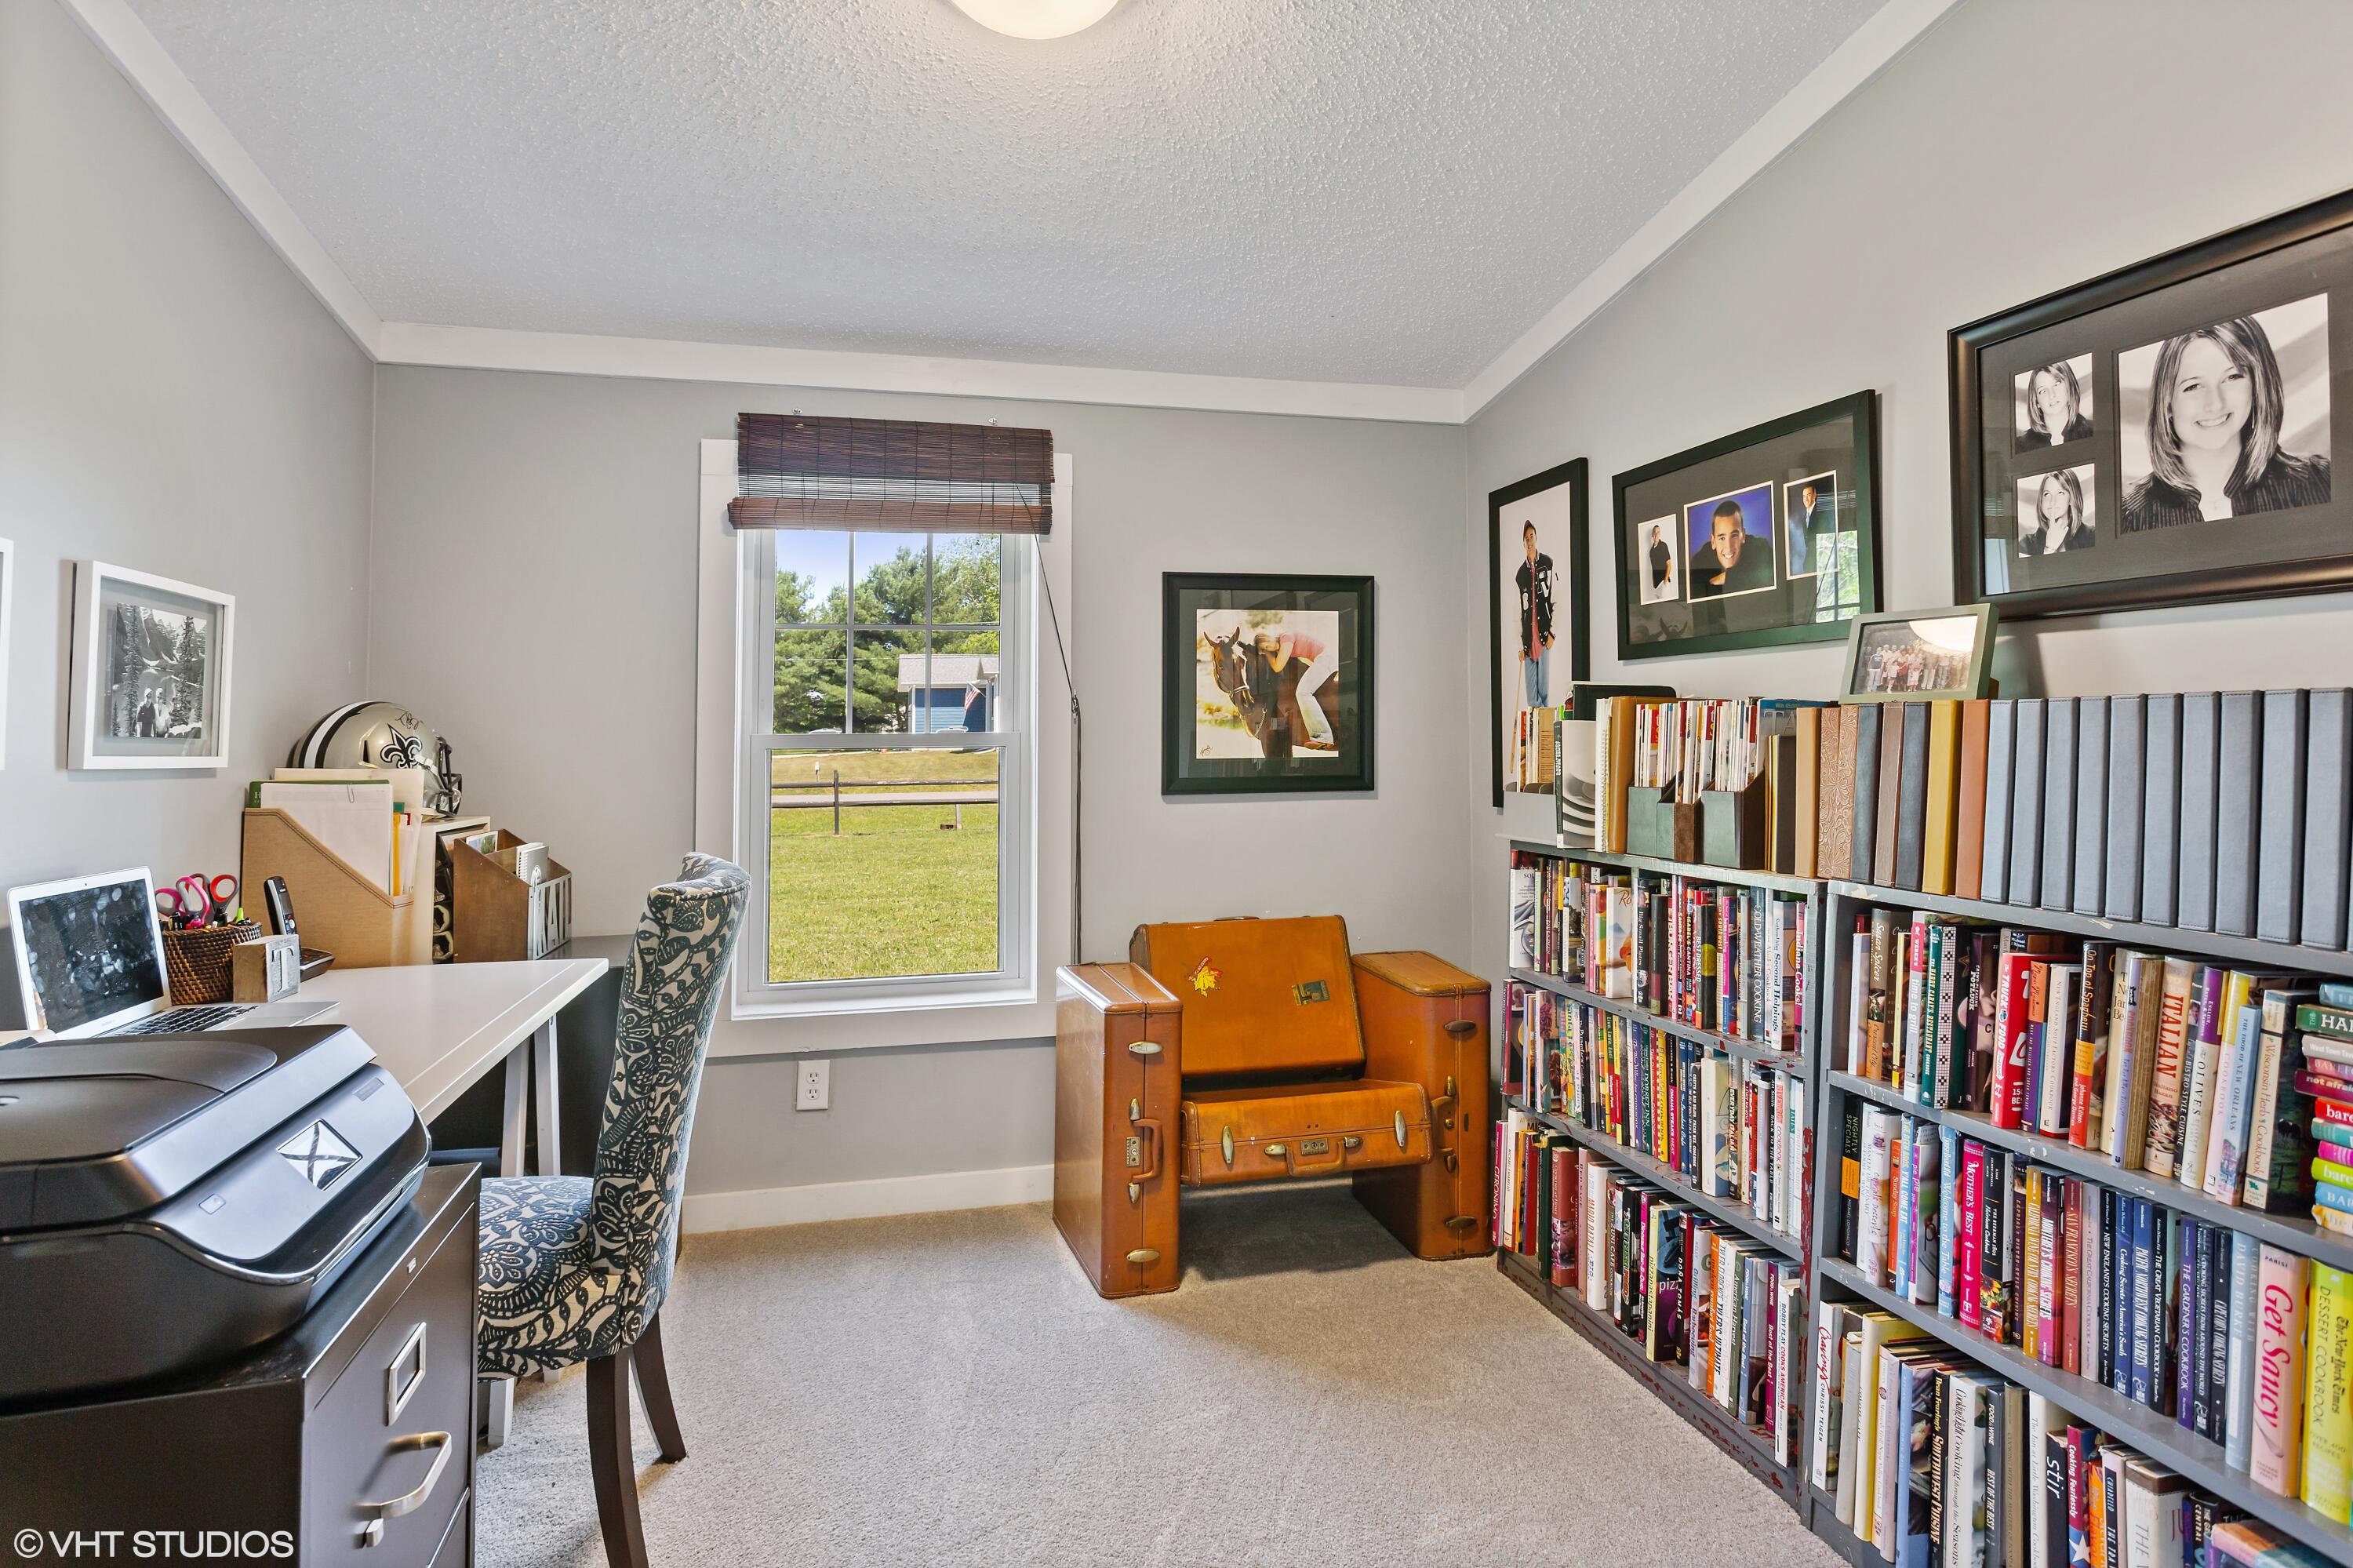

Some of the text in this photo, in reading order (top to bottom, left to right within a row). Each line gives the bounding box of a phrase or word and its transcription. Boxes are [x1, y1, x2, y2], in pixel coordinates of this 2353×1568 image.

[271, 945, 295, 992] T
[1754, 905, 1762, 1023] COLD-WEATHER COOKING
[1872, 922, 1885, 983] Susan Spicer
[1772, 989, 1780, 1031] Helpings
[1795, 971, 1803, 1006] Cooks!
[1909, 979, 1921, 1034] time to grill
[2000, 974, 2010, 1010] TRUCK
[2080, 949, 2097, 1031] On Top of Spaghetti
[1998, 1023, 2008, 1050] FOOD
[2156, 991, 2184, 1079] ITALIAN
[2239, 1053, 2245, 1061] OF
[2192, 1061, 2206, 1115] OLIVES
[2218, 1053, 2232, 1116] COOKBOOK
[2235, 1064, 2244, 1083] NEW
[2077, 1084, 2087, 1123] Johanne Killeen
[2177, 1060, 2192, 1145] BISTRO-STYLE CUISINE
[2229, 1087, 2241, 1130] ORLEANS
[2253, 1045, 2276, 1172] Wisconsin Herb Cookbook
[1890, 1176, 1900, 1217] Sunday Soup
[1901, 1170, 1910, 1189] Y'ALL
[1942, 1183, 1951, 1220] Welcome
[1965, 1162, 1979, 1235] MOTHER'S BEST
[1900, 1210, 1908, 1224] EAT
[1941, 1234, 1951, 1248] the
[1942, 1223, 1950, 1231] to
[1940, 1251, 1951, 1275] Table
[2039, 1217, 2053, 1321] MONTEREY'S COOKING SECRETS
[2065, 1211, 2078, 1308] SAN FRANCISCO'S SECRETS
[2119, 1249, 2128, 1277] Cooking
[2264, 1256, 2289, 1268] PARISI
[1647, 1255, 1657, 1332] pizzapastapanini
[2134, 1247, 2148, 1366] PACIFIC NORTHWEST COOKING SECRETS
[2182, 1286, 2191, 1334] GARDENER'S
[2263, 1285, 2293, 1337] Get
[1714, 1302, 1724, 1375] TYLER'S ULTIMATE
[1817, 1326, 1832, 1394] Cravings
[2180, 1337, 2190, 1390] COOKBOOK
[2312, 1286, 2332, 1425] DESSERT COOKBOOK
[2253, 1339, 2290, 1428] Saucy
[2329, 1316, 2350, 1414] The New York Times
[1933, 1377, 1944, 1432] Dean Fearing's
[1953, 1435, 1963, 1480] Cooking
[2046, 1456, 2064, 1498] stir
[2067, 1445, 2078, 1518] Cooking Fearlessly
[1930, 1434, 1944, 1544] SOUTHWEST CUISINE
[1952, 1480, 1962, 1510] through
[1987, 1468, 1995, 1530] BEST OF THE BEST
[1952, 1523, 1961, 1566] Seasons
[2108, 1526, 2116, 1563] THE TRA
[2136, 1524, 2149, 1559] THE
